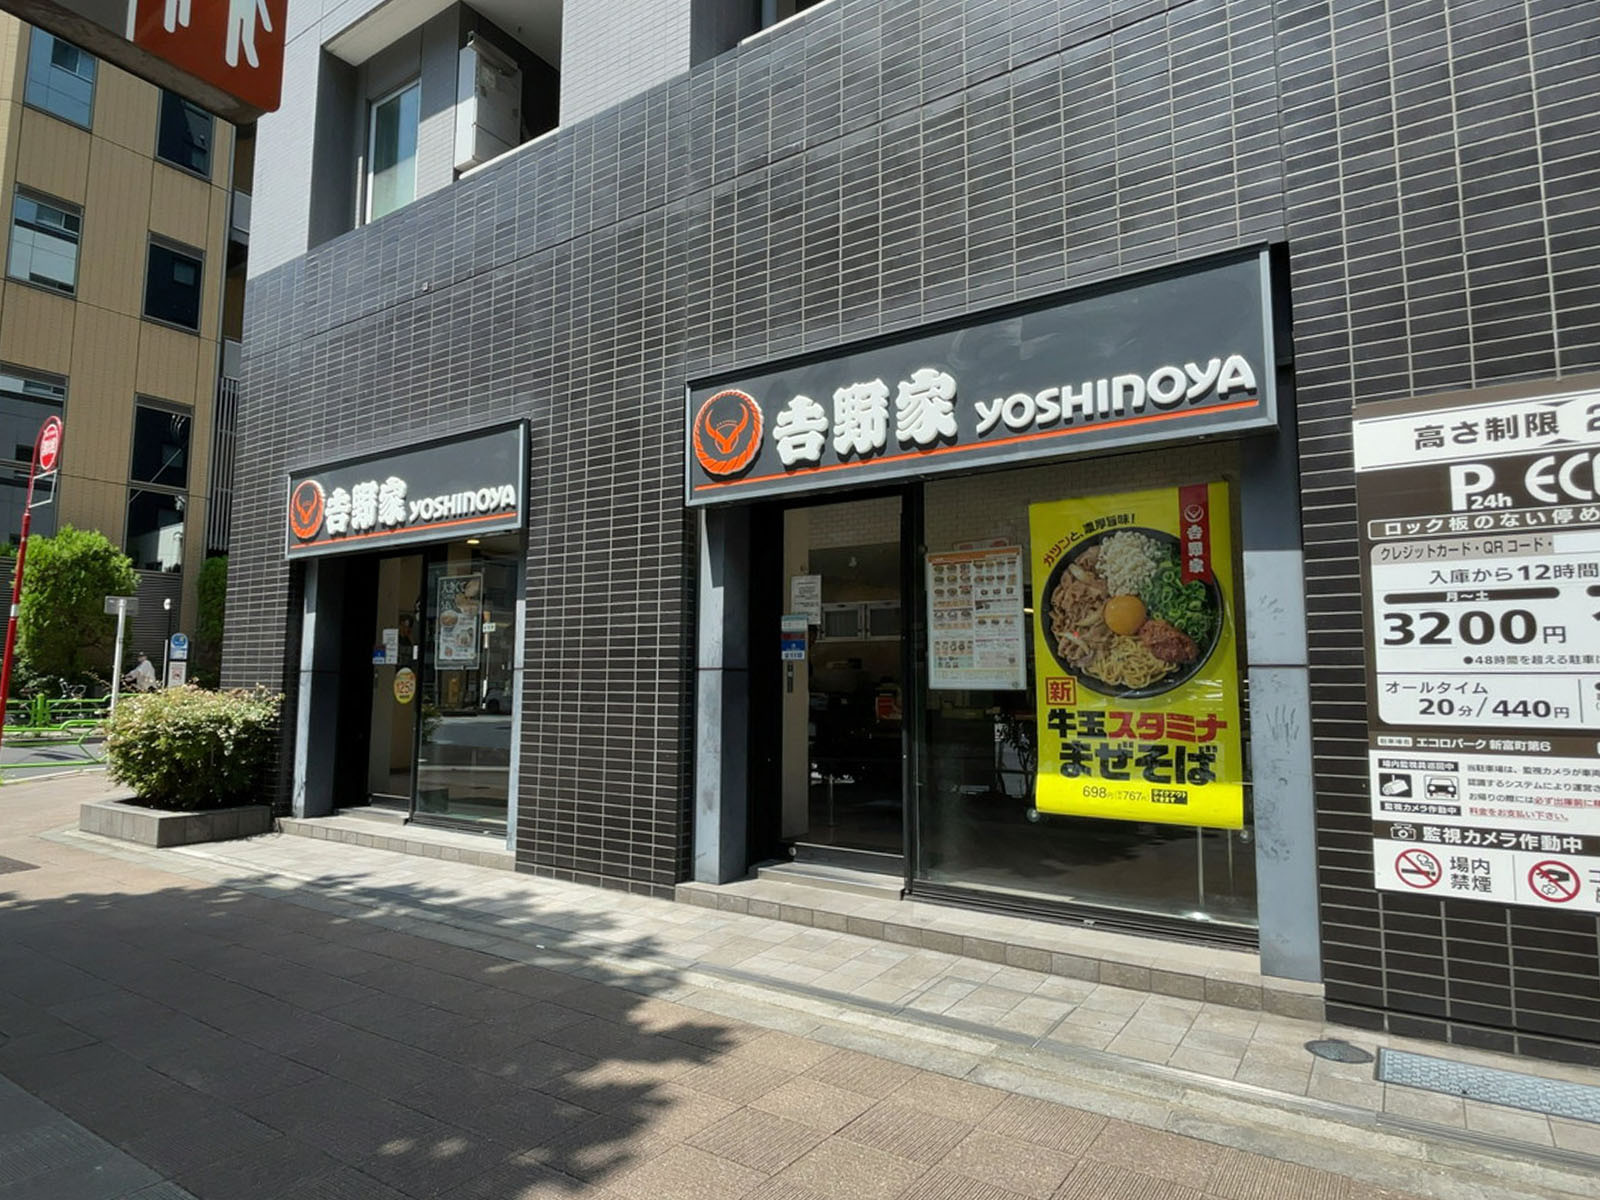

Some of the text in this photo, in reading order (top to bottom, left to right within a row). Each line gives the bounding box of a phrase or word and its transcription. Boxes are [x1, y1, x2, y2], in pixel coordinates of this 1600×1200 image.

[975, 355, 1256, 435] YOSHINOYA
[1414, 411, 1559, 450] 高さ制限
[1450, 452, 1600, 511] P 24h EC
[409, 484, 517, 521] YOSHINOYA
[1384, 508, 1600, 535] ロック板のない停め
[1429, 563, 1599, 585] 入庫から12時間
[1383, 609, 1567, 645] 3200円
[1050, 681, 1072, 702] 新
[1385, 681, 1489, 695] オールタイム
[1048, 708, 1227, 743] 牛玉スタミナ
[1489, 738, 1552, 752] 新富町第6
[1059, 740, 1217, 786] まぜそば
[1423, 827, 1583, 853] 監視カメラ作動中
[1450, 856, 1491, 876] 場内
[1450, 874, 1492, 893] 禁煙
